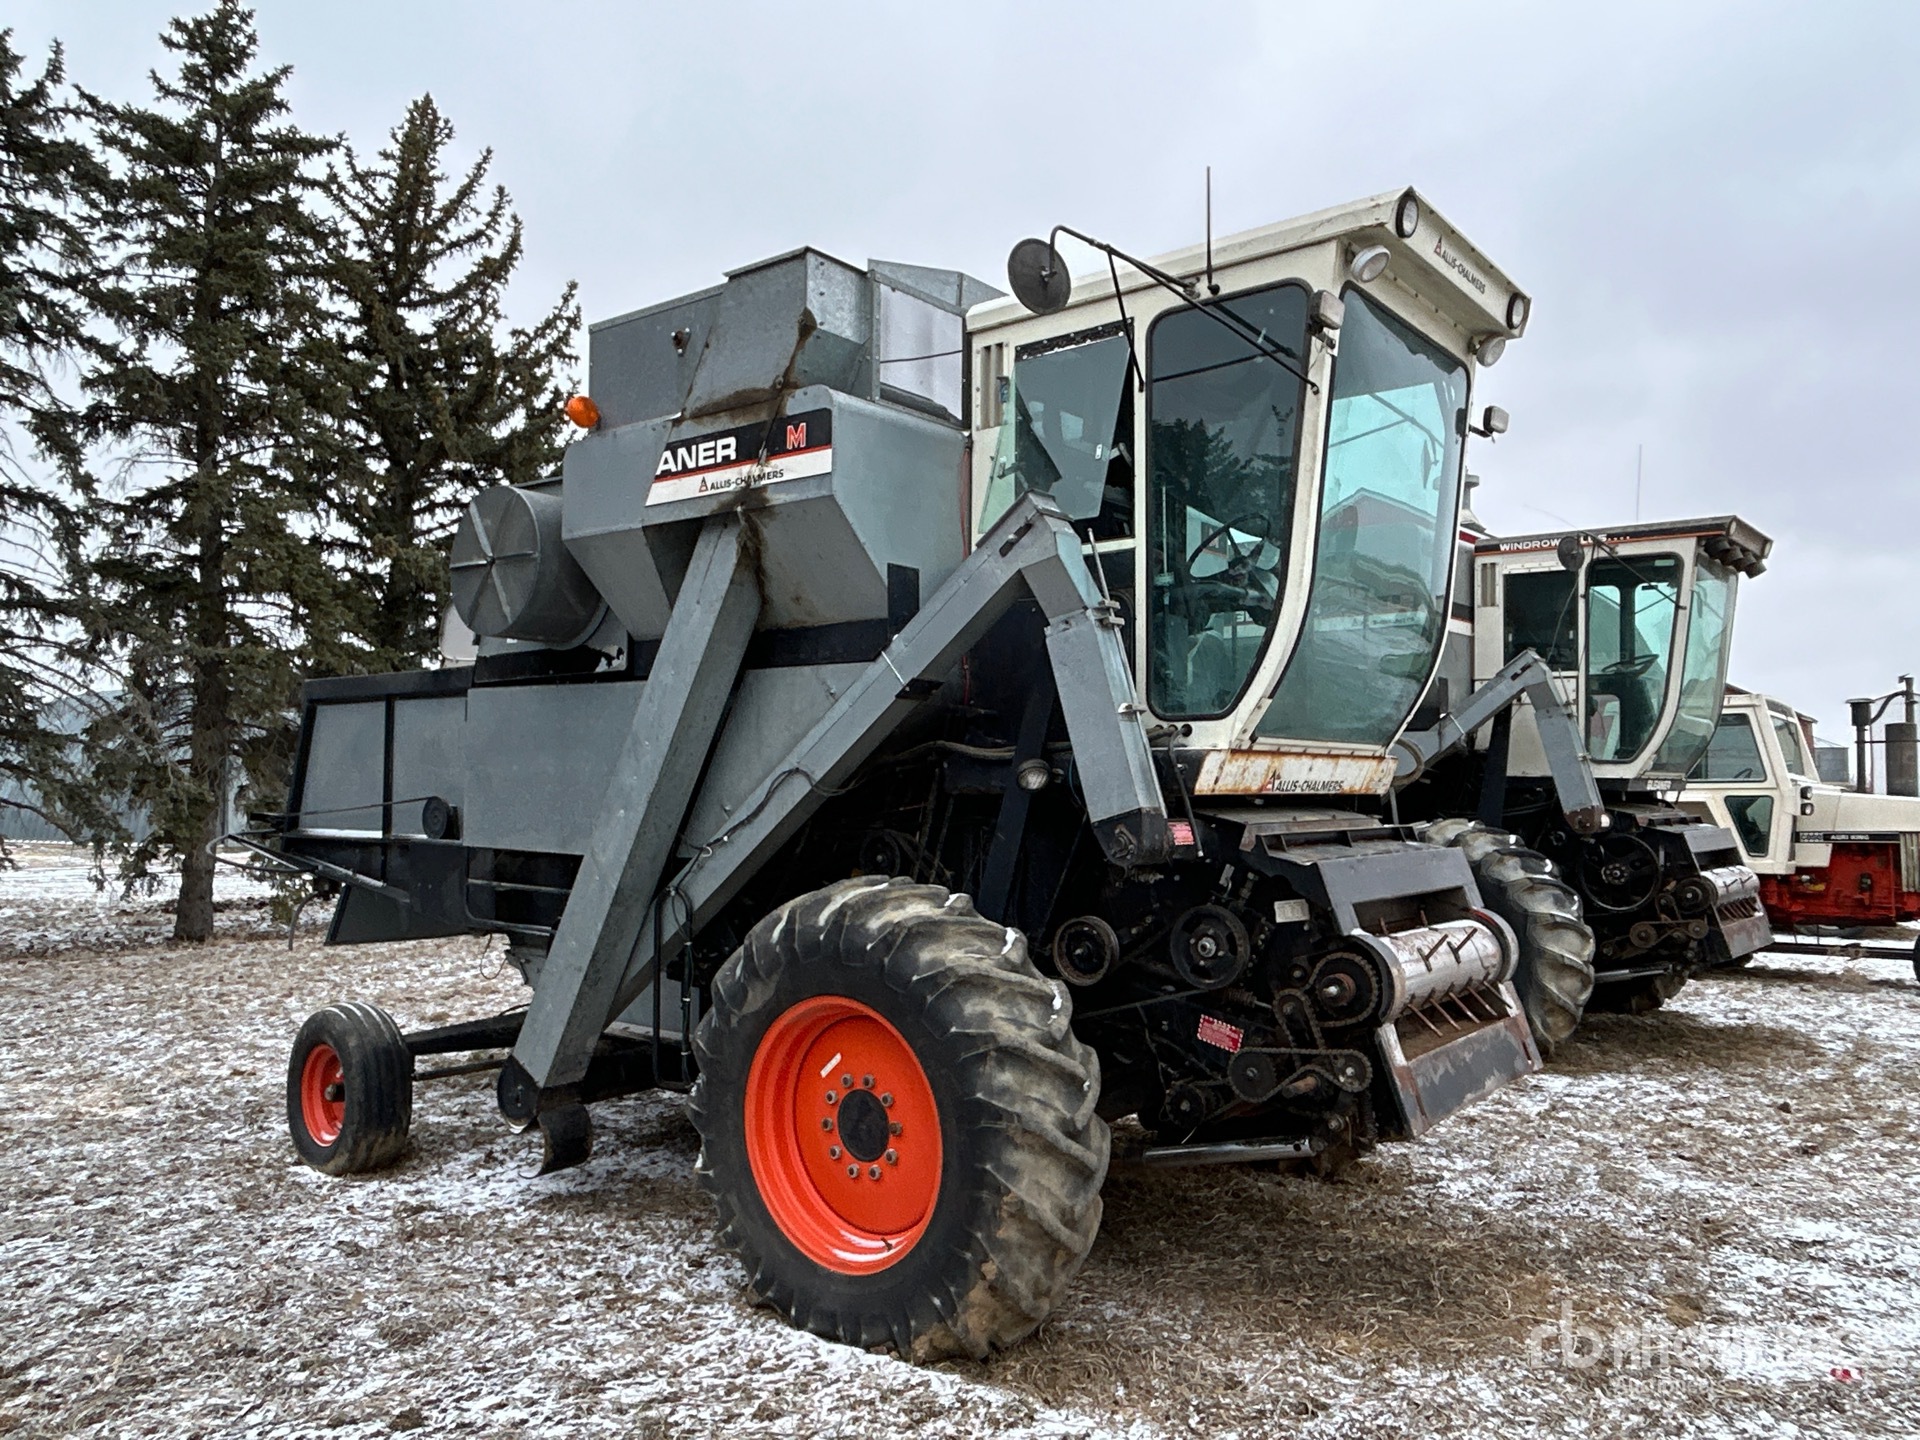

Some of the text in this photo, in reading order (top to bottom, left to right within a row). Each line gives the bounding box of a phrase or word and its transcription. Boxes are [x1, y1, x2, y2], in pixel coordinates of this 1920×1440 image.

[1441, 249, 1486, 295] ALLIS-CHALMERS
[655, 422, 807, 476] ANER M
[1275, 780, 1345, 793] ALLIS-CHALMERS
